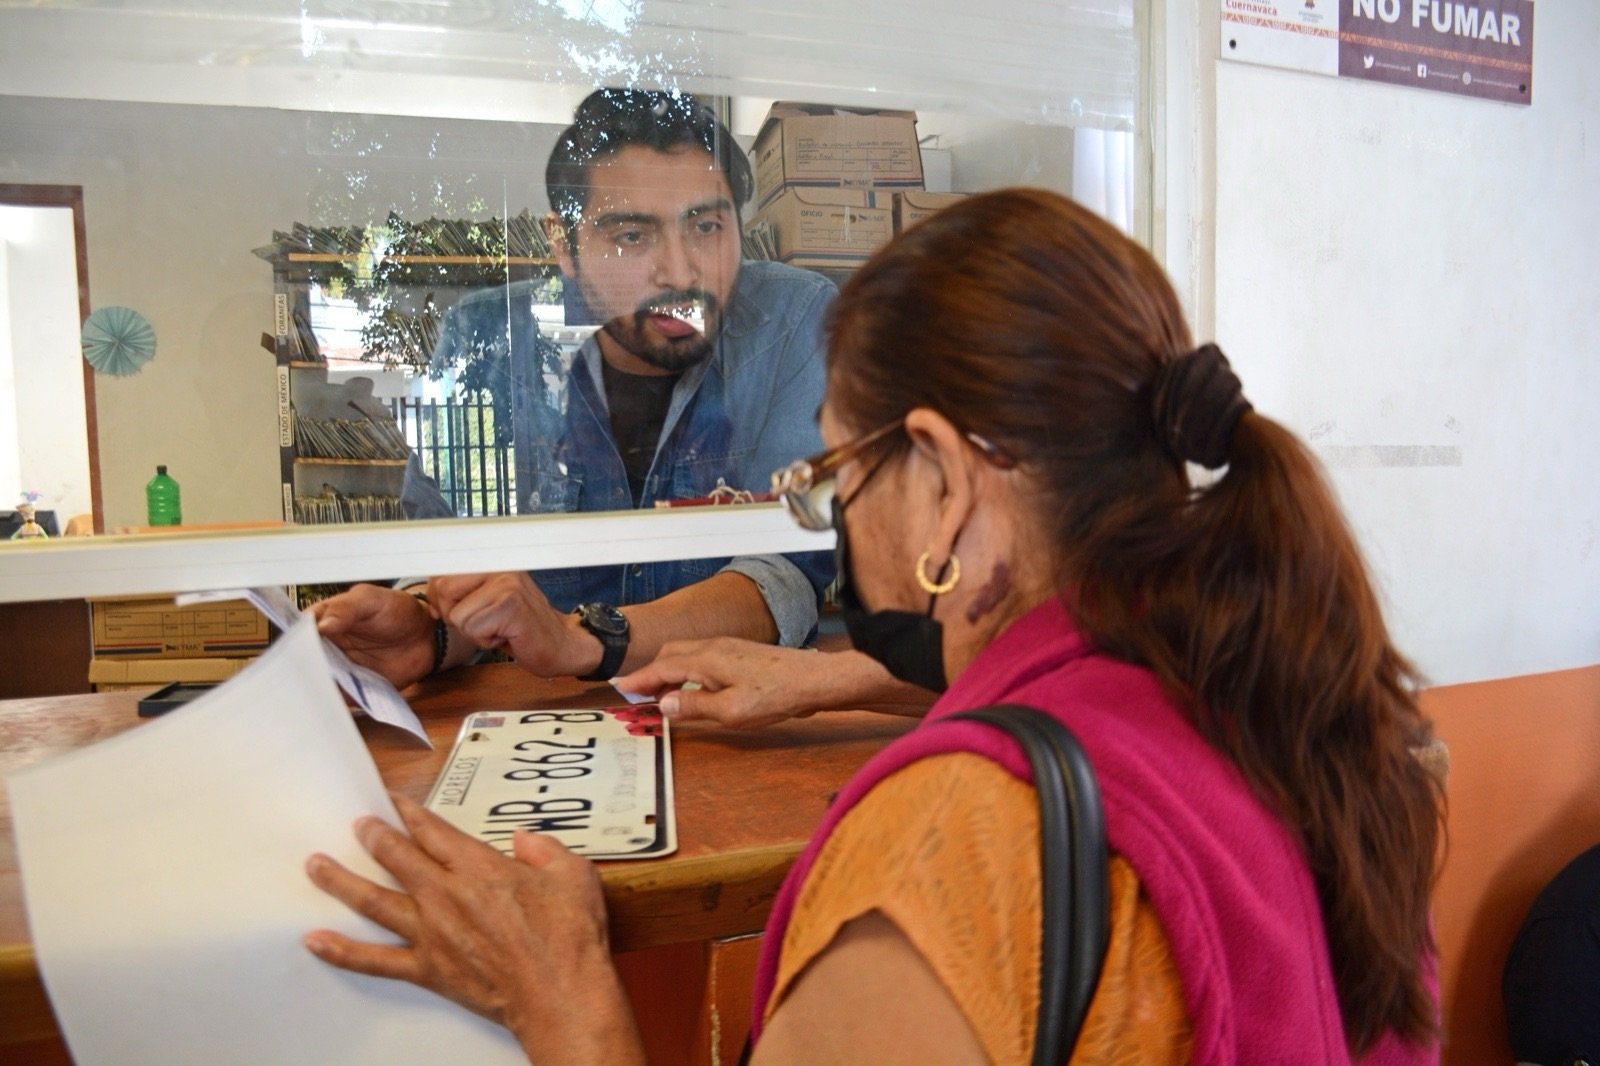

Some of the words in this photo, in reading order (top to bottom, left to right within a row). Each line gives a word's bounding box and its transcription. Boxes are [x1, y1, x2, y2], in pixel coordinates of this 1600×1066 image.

[1225, 0, 1278, 16] Cuernavaca
[1353, 0, 1400, 23] NO
[1412, 0, 1521, 46] FUMAR
[281, 406, 288, 415] DE
[281, 416, 290, 446] ESTADO
[438, 756, 478, 806] MORELOS
